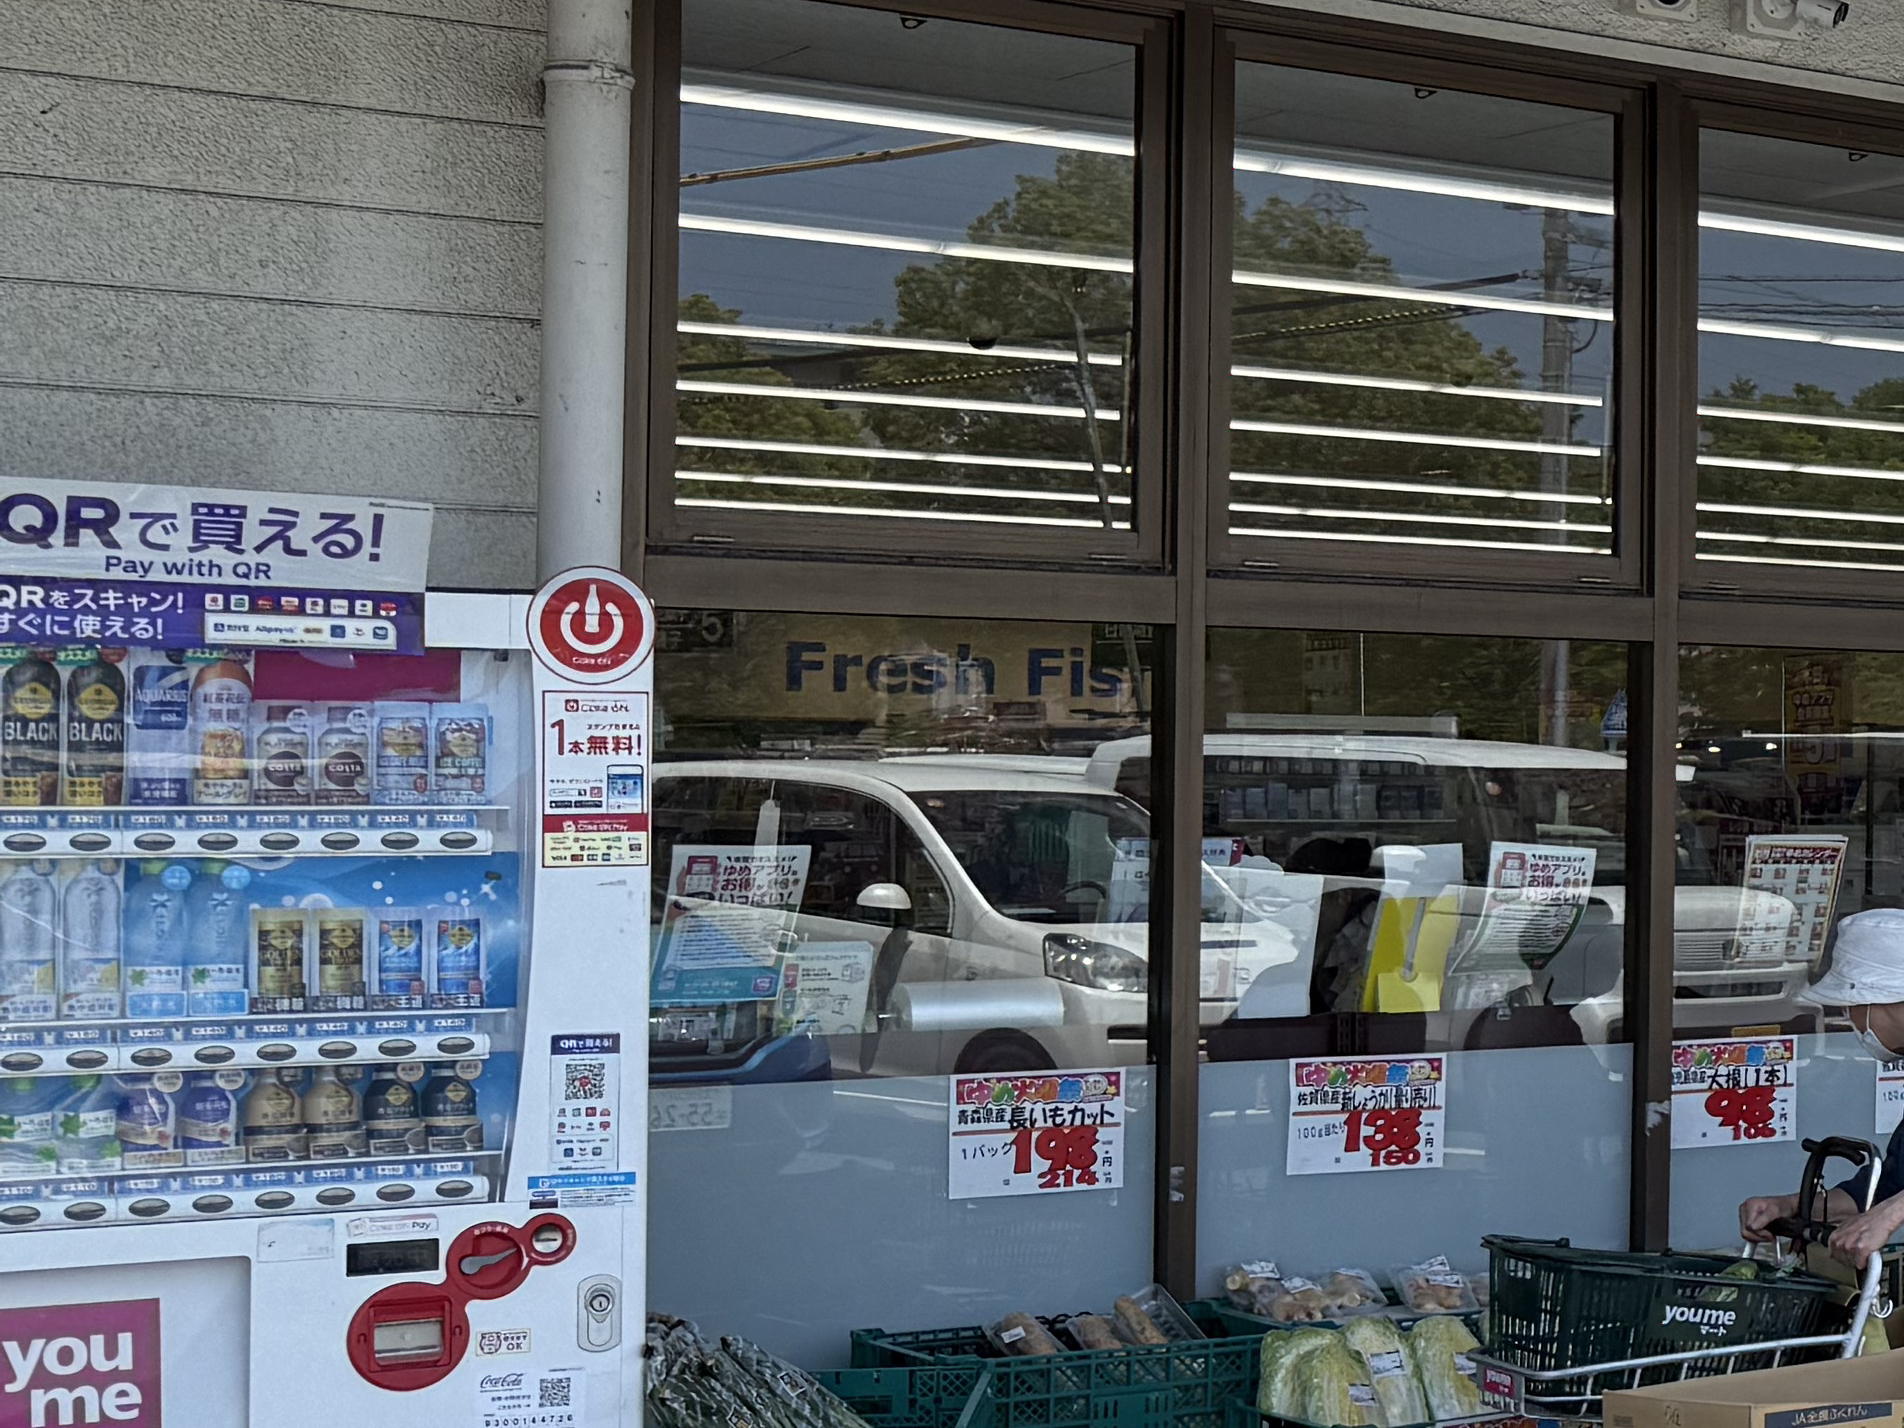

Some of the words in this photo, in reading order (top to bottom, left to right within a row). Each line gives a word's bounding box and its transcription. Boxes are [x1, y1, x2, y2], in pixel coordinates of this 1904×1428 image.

[0, 492, 385, 563] QRで買える!
[104, 555, 155, 579] Pay
[161, 557, 223, 578] with
[232, 561, 273, 581] QR
[0, 584, 185, 614] QRをスキャン!
[0, 613, 164, 641] すぐに使える!
[785, 640, 996, 696] Fresh
[4, 721, 58, 741] BLACK
[69, 721, 123, 742] BLACK
[957, 1107, 1008, 1125] 青森県産
[1008, 1103, 1115, 1130] 長いもカット
[1704, 1086, 1777, 1128] 98
[1343, 1108, 1423, 1153] 138
[1011, 1125, 1100, 1175] 198
[1037, 1168, 1099, 1189] 214
[411, 1221, 431, 1231] Pay
[1662, 1304, 1737, 1327] youme
[1699, 1324, 1727, 1337] マート
[506, 1341, 523, 1351] OK
[2, 1332, 134, 1393] you
[30, 1382, 142, 1428] me
